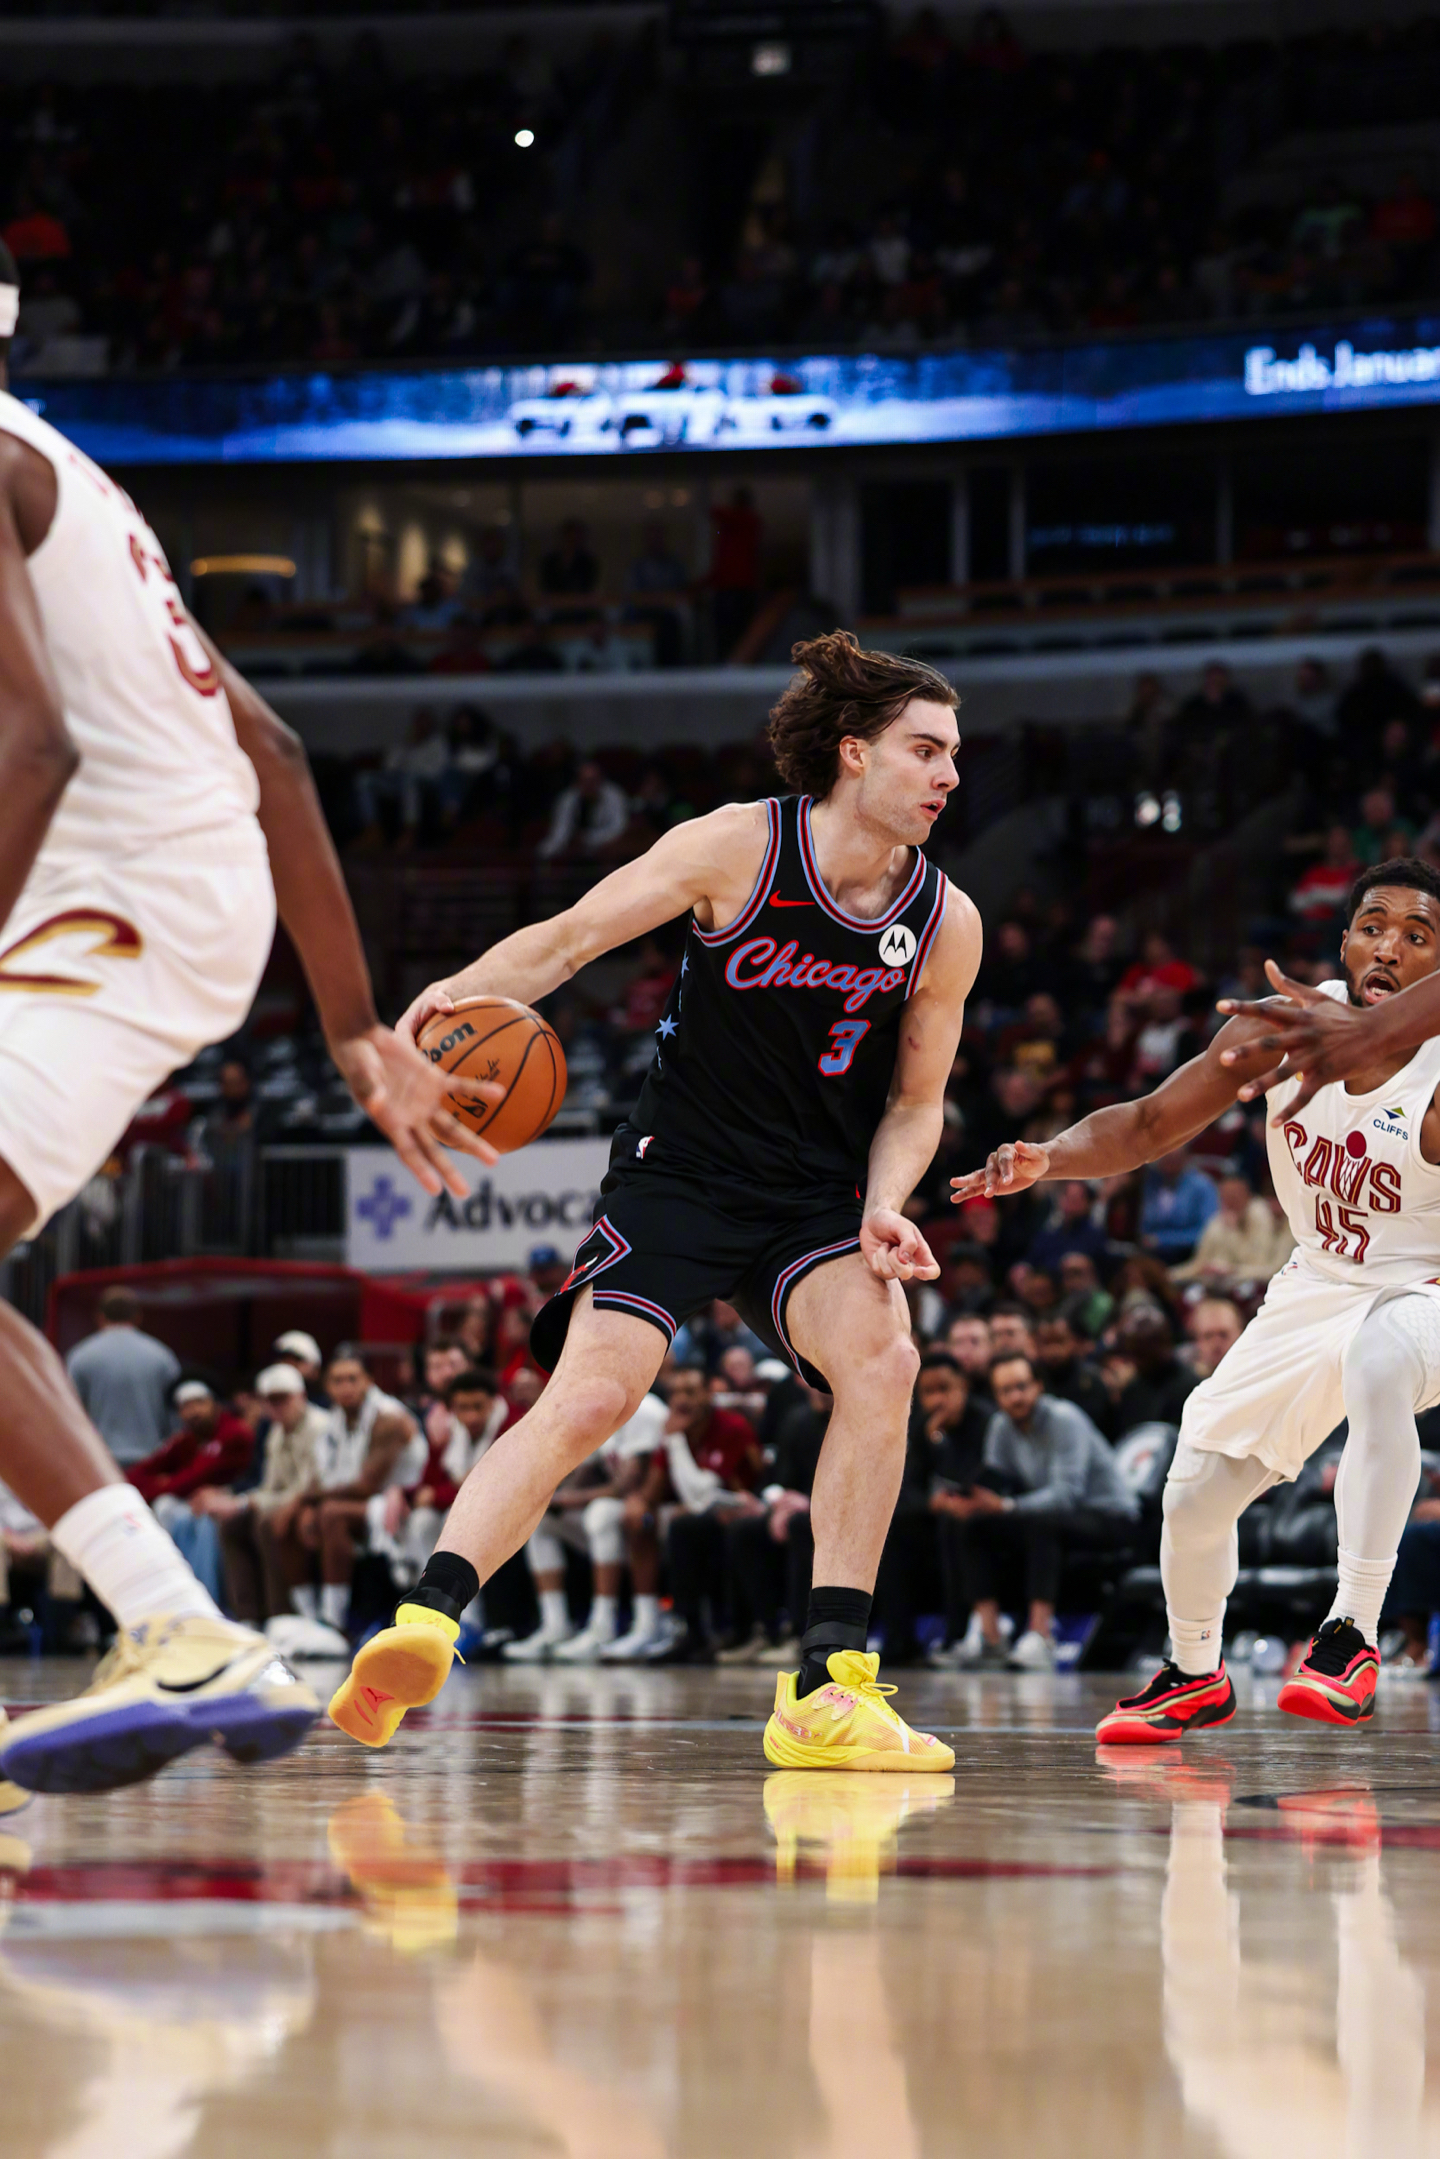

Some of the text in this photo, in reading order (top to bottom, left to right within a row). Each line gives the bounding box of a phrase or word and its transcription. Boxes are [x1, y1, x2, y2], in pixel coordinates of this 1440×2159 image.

[725, 936, 906, 1013] Chicago
[818, 1019, 872, 1076] 3
[1373, 1119, 1409, 1141] CLIFFS
